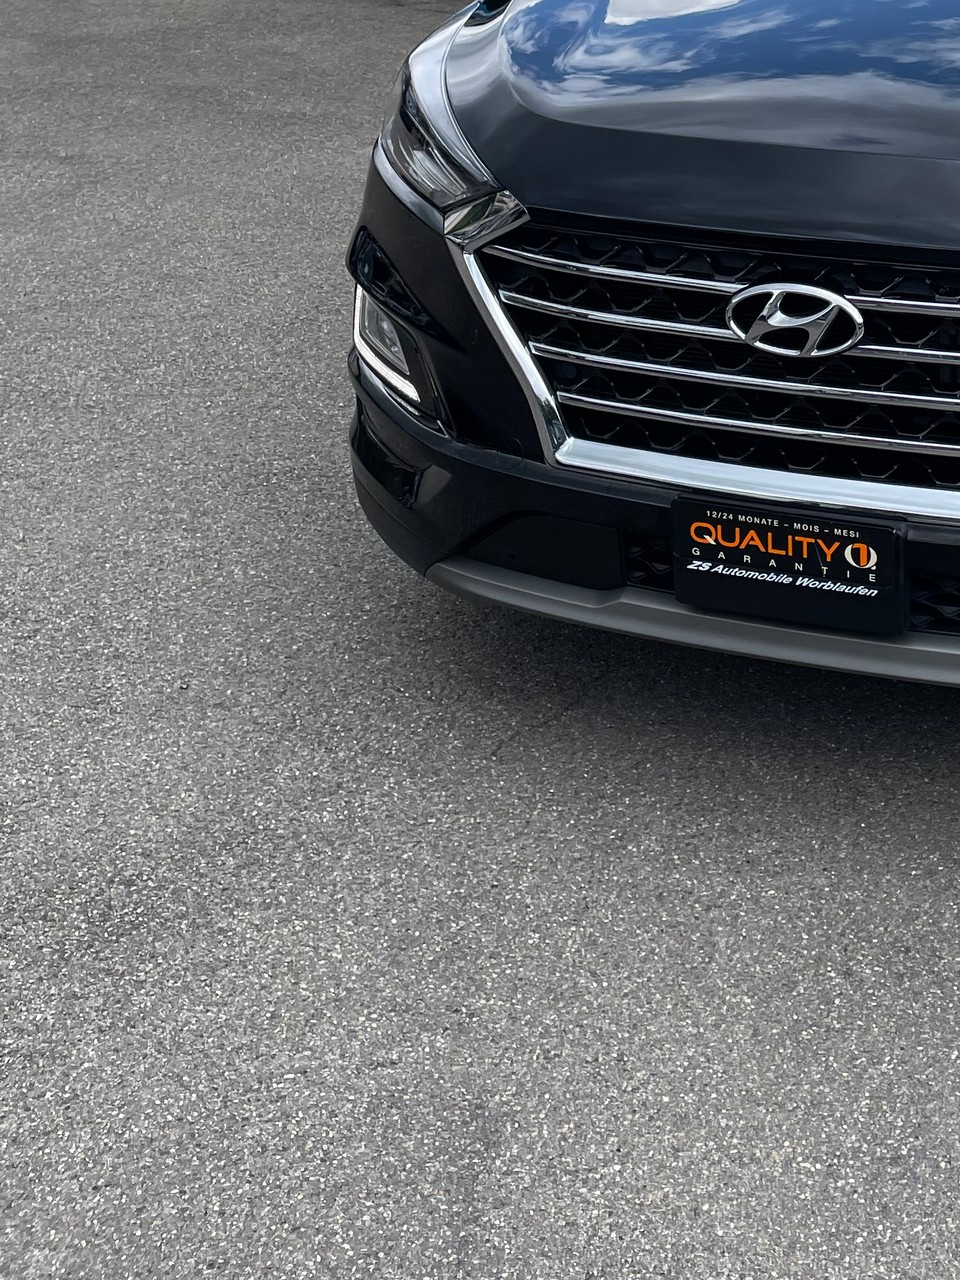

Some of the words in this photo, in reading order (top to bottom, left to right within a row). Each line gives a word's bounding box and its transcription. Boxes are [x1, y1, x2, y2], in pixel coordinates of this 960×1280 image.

[689, 521, 841, 562] QUALITY
[706, 510, 734, 521] 12/24
[738, 513, 780, 527] MONATE
[793, 522, 820, 533] MOIS
[834, 527, 860, 538] MESI
[686, 560, 713, 572] ZS
[710, 564, 793, 585] Automobile
[795, 576, 879, 598] Worblaufen
[691, 547, 876, 582] GARANTIE
